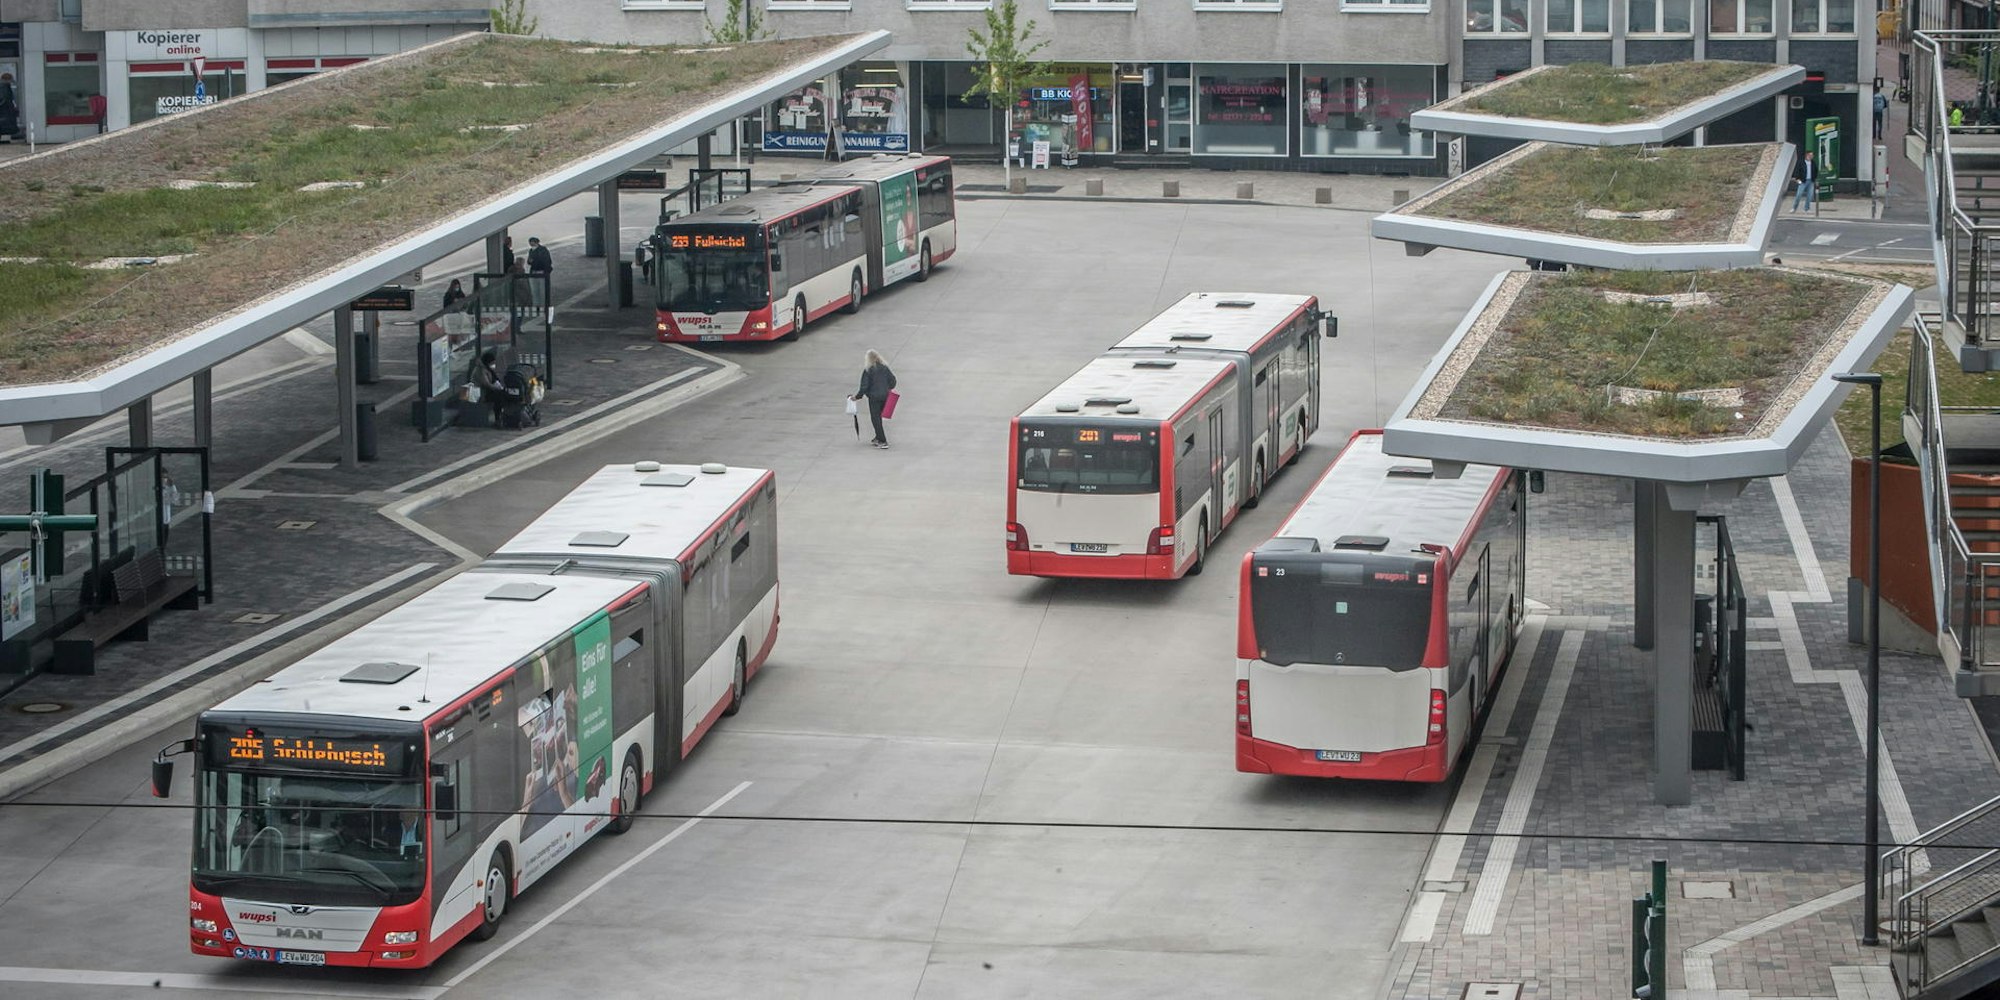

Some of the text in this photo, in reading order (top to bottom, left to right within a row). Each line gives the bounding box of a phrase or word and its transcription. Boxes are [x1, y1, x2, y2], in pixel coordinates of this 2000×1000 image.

[137, 31, 200, 46] Kopierer
[166, 45, 201, 54] online
[1041, 90, 1055, 98] BB
[414, 272, 421, 282] 5
[678, 316, 712, 326] wupsi
[1079, 430, 1099, 442] 201
[1275, 568, 1286, 576] 23
[240, 911, 277, 922] wupsi
[276, 927, 324, 940] MAN
[281, 952, 324, 962] LEV WU 204
